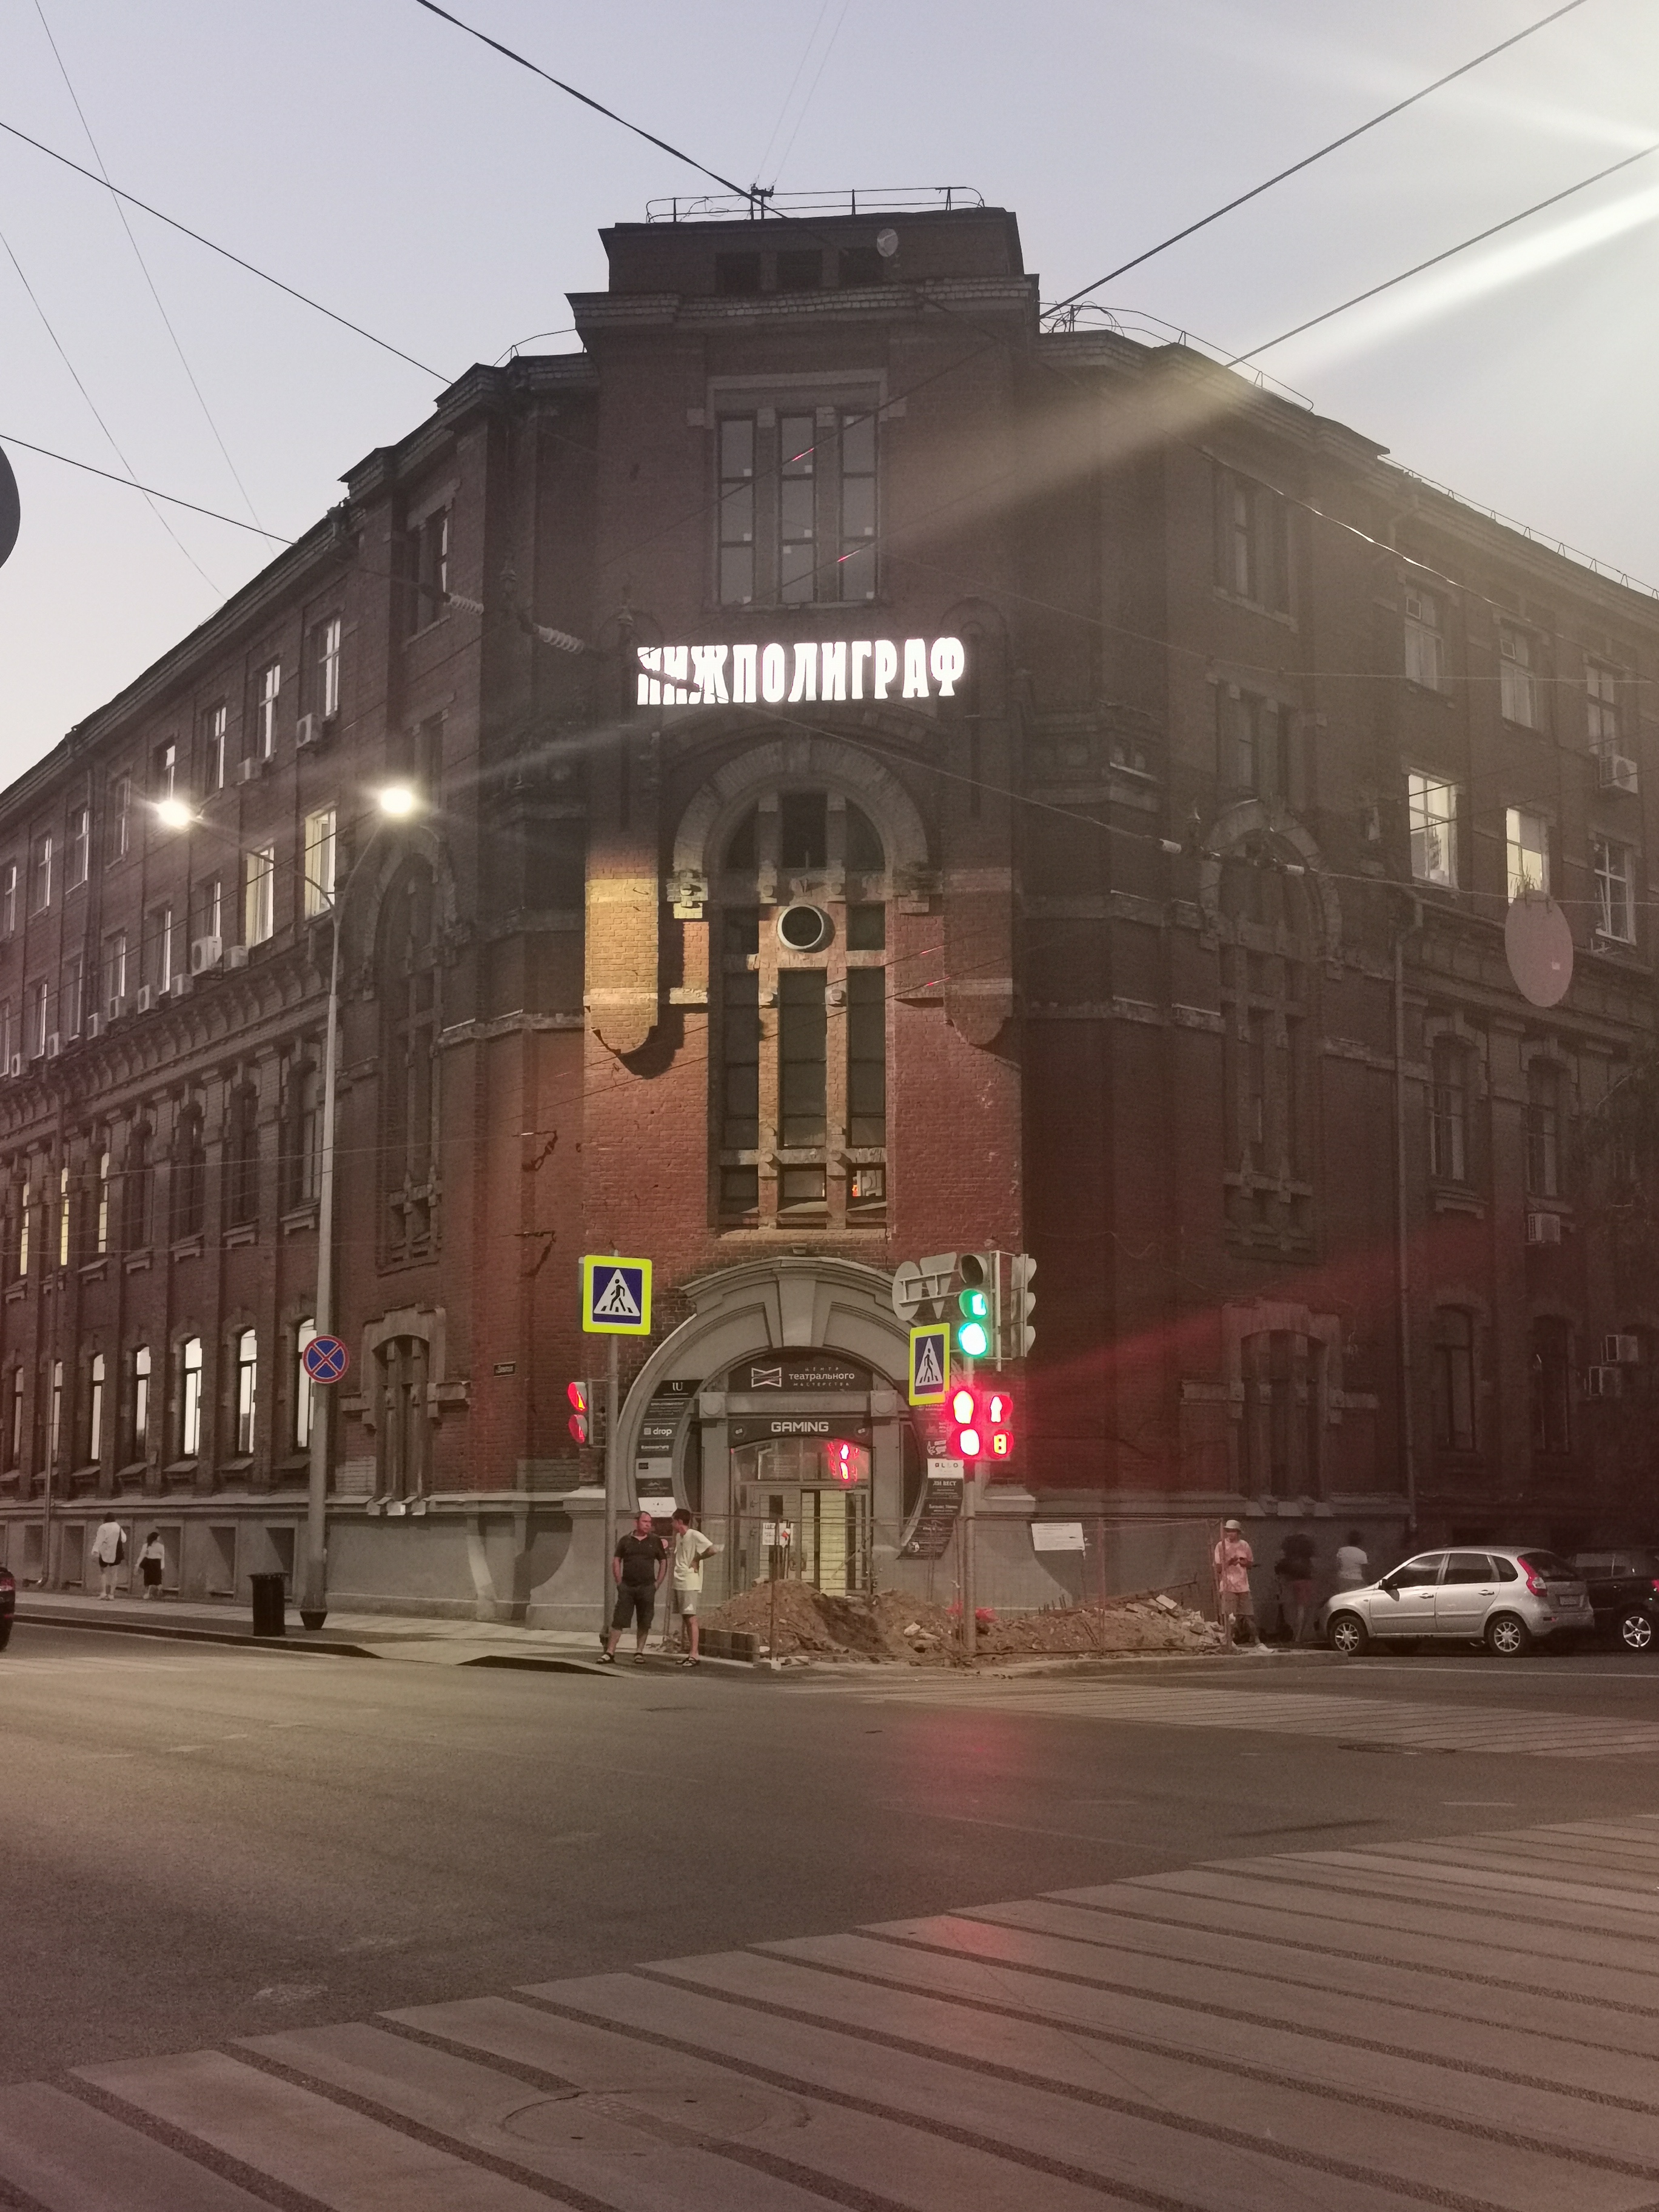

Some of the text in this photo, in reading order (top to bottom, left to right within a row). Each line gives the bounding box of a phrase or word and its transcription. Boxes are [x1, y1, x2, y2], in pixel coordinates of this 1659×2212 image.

[637, 637, 965, 706] НИЖПОЛИГРАФ
[788, 1373, 856, 1382] театрального
[652, 1427, 672, 1436] drop
[771, 1421, 829, 1432] GAMING
